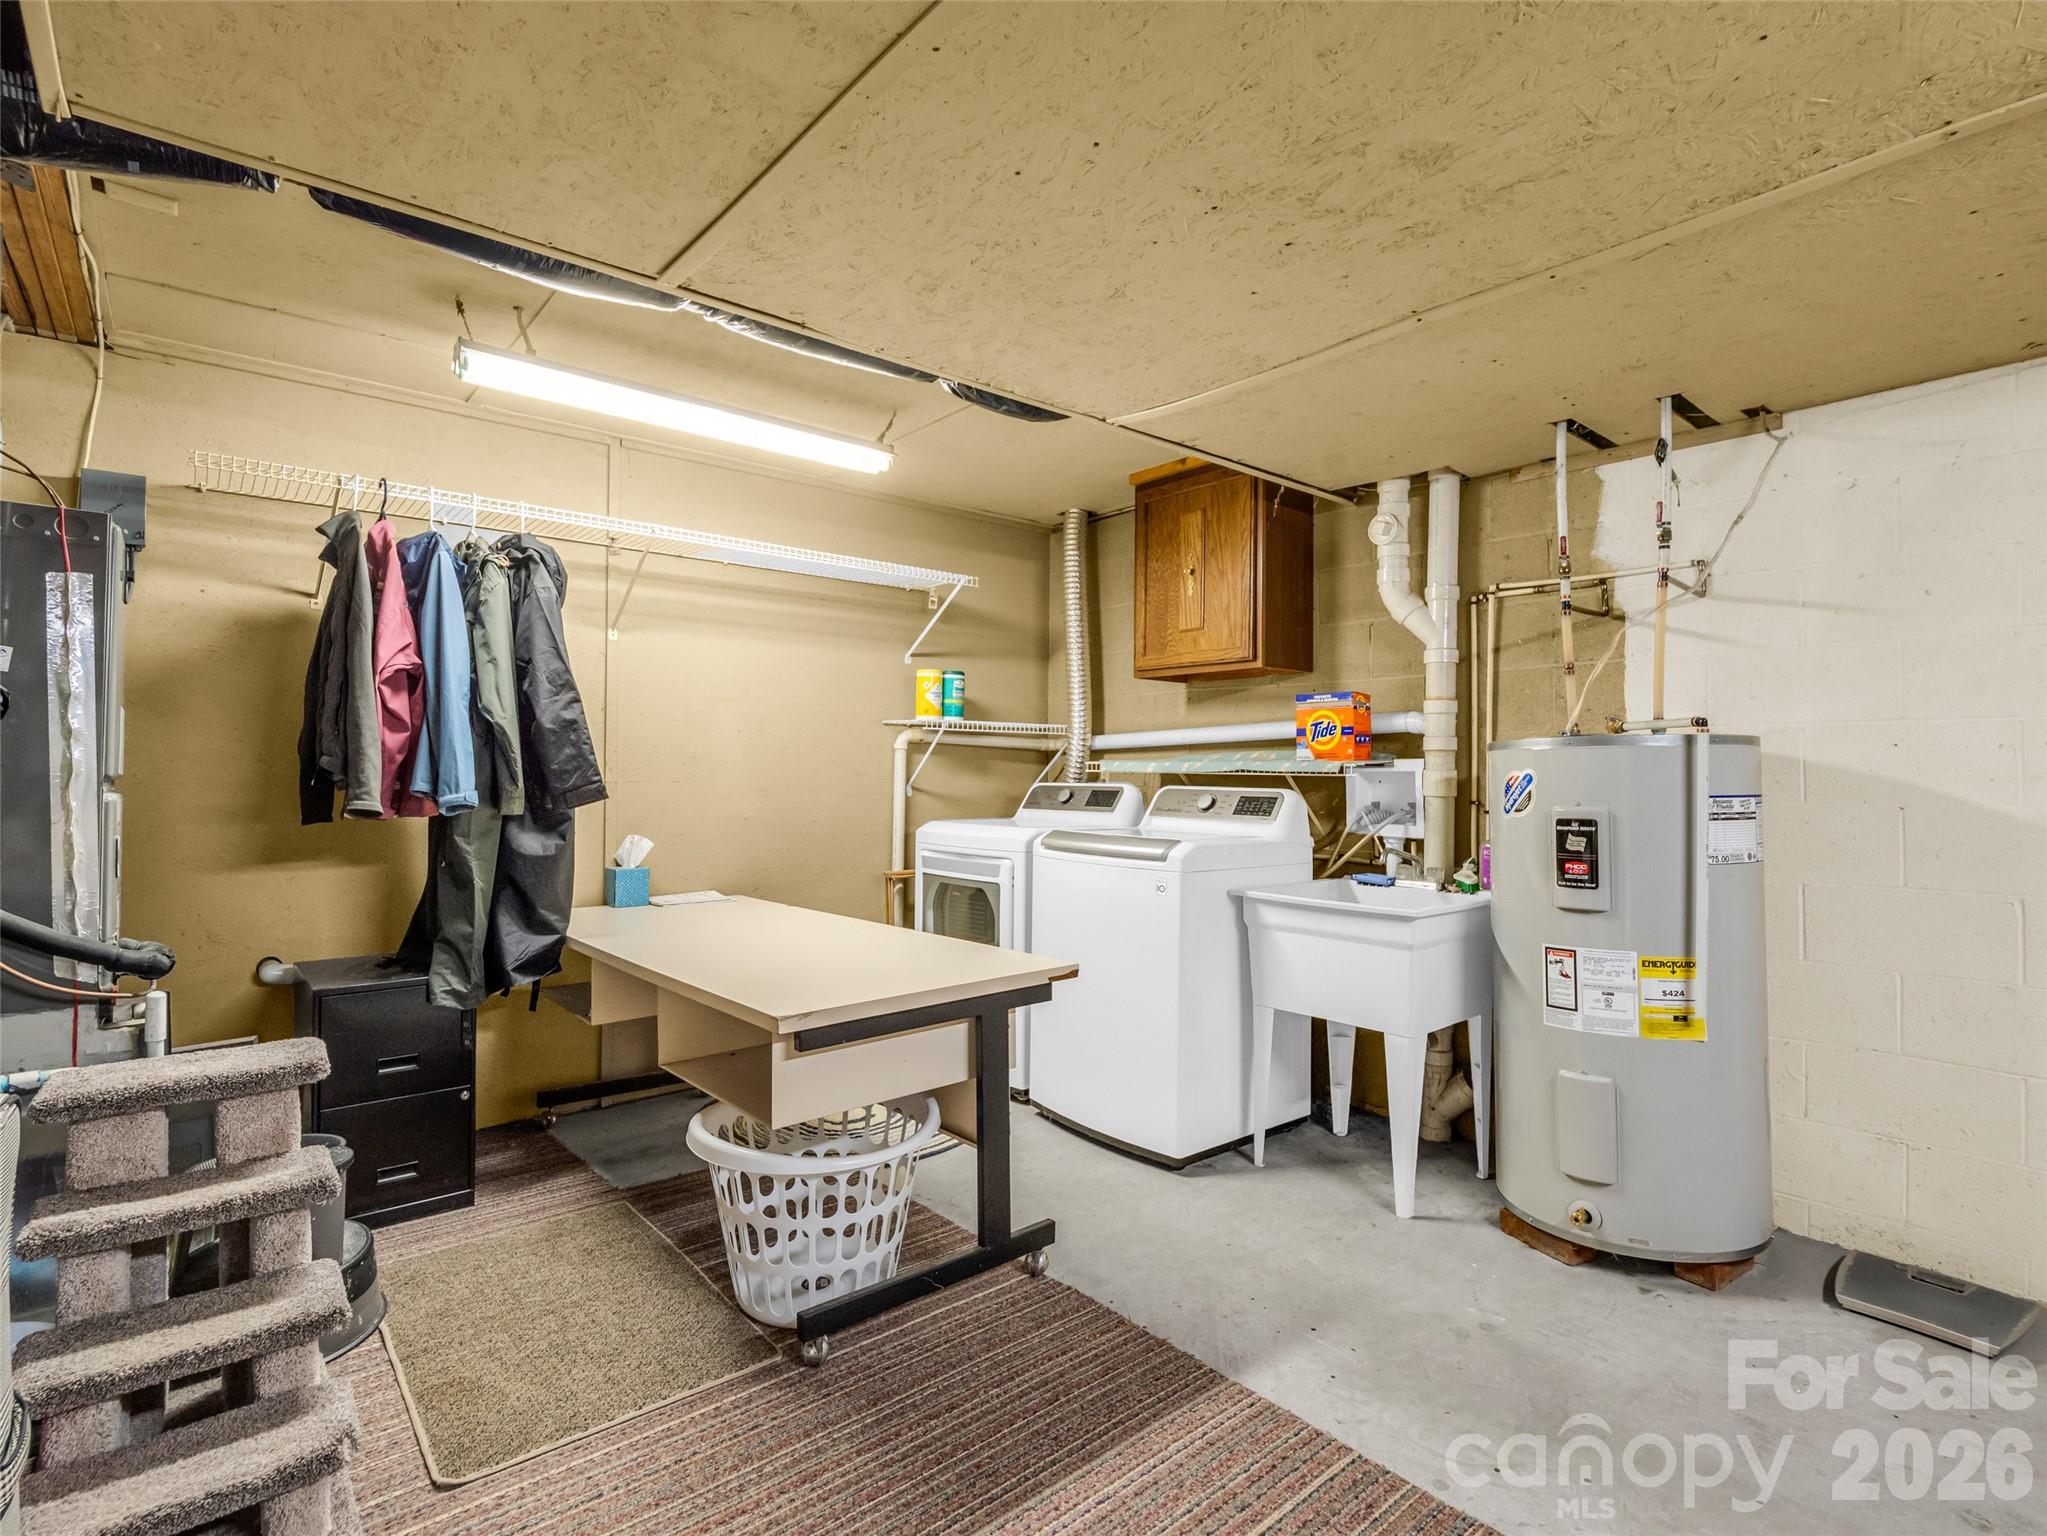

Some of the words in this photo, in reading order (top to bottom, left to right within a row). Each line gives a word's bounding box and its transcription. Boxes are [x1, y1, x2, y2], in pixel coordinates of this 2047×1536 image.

[1310, 720, 1337, 743] Tide
[1711, 855, 1730, 863] 75.00
[1641, 960, 1696, 969] ENERGYGUID
